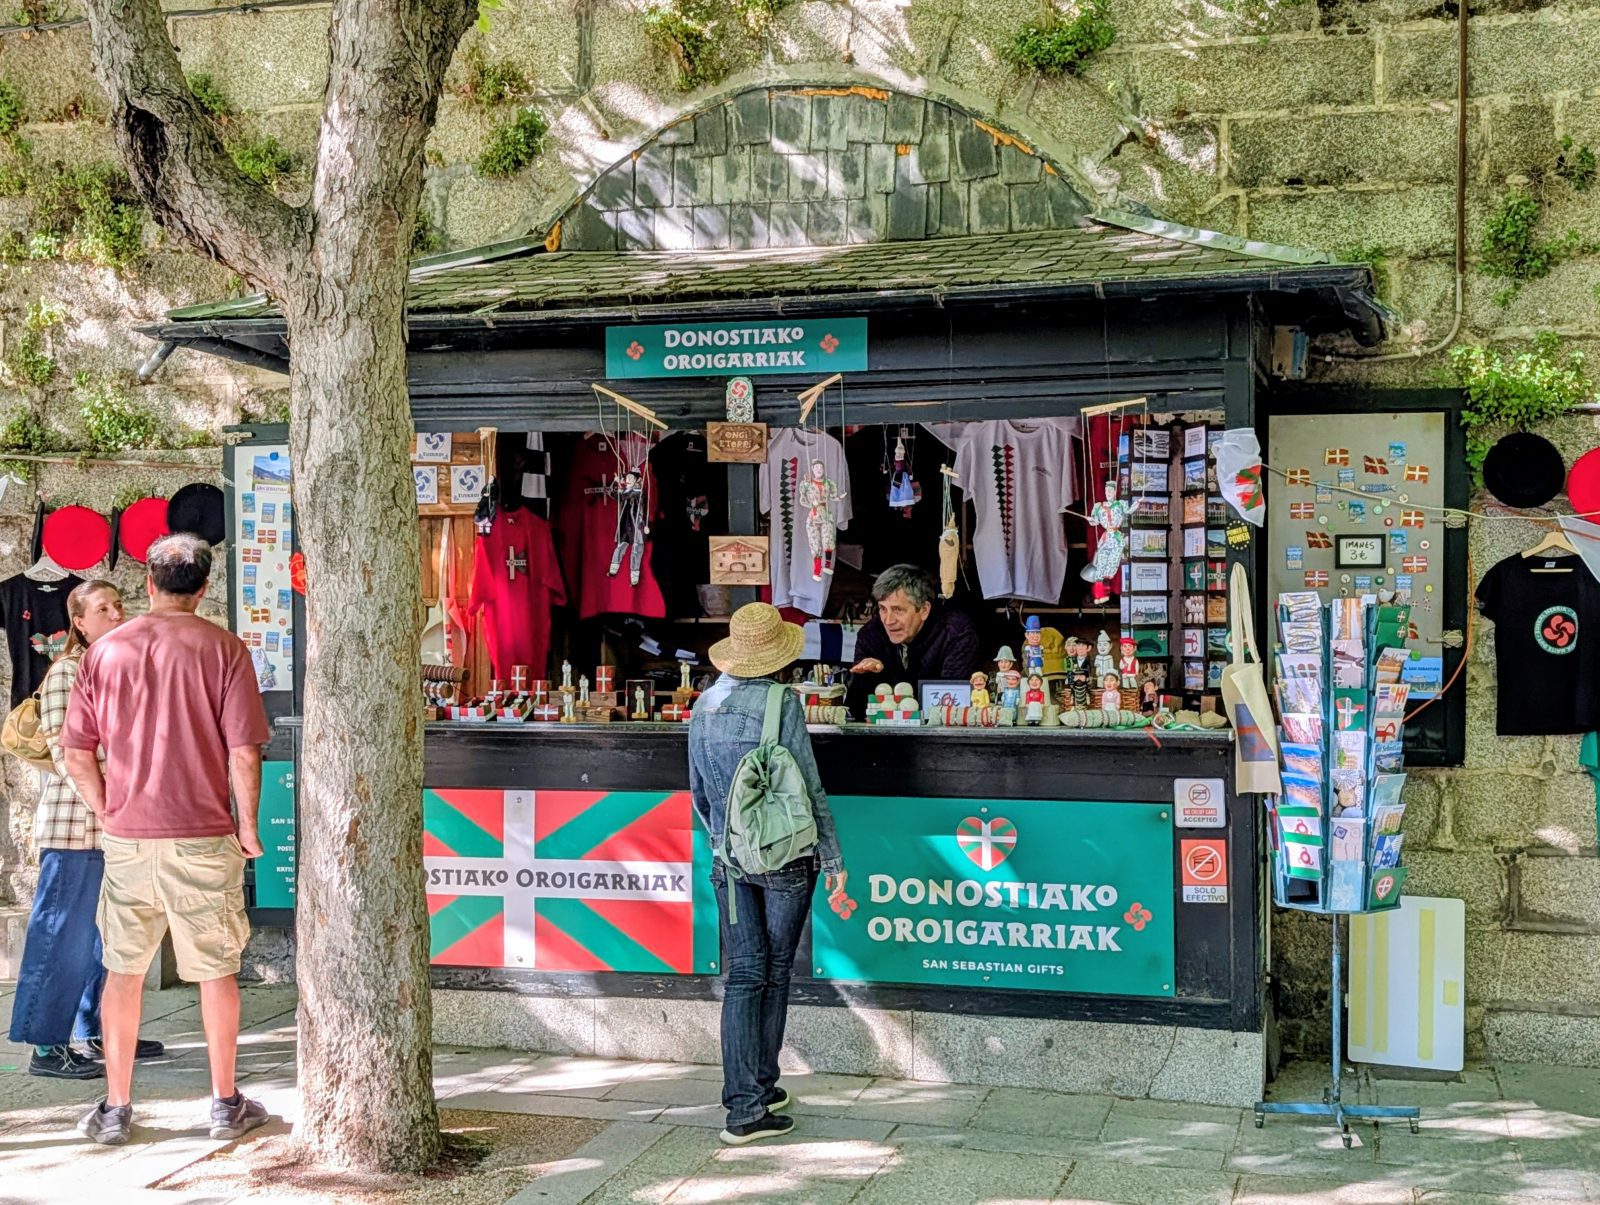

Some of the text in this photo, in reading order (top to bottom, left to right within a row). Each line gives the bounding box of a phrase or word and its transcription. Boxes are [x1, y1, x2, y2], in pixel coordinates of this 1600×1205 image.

[664, 327, 804, 348] DONOSTIAKO
[663, 351, 806, 370] OROIGARRIAK
[1345, 541, 1375, 550] IMANES
[516, 868, 686, 892] OROIGARRIAK
[868, 874, 1118, 911] DONOSTIAKO
[1186, 894, 1225, 902] EFECTIVO
[867, 916, 1122, 952] OROIGARRIAK
[922, 959, 1065, 975] SAN SEBASTIAN GIFTS
